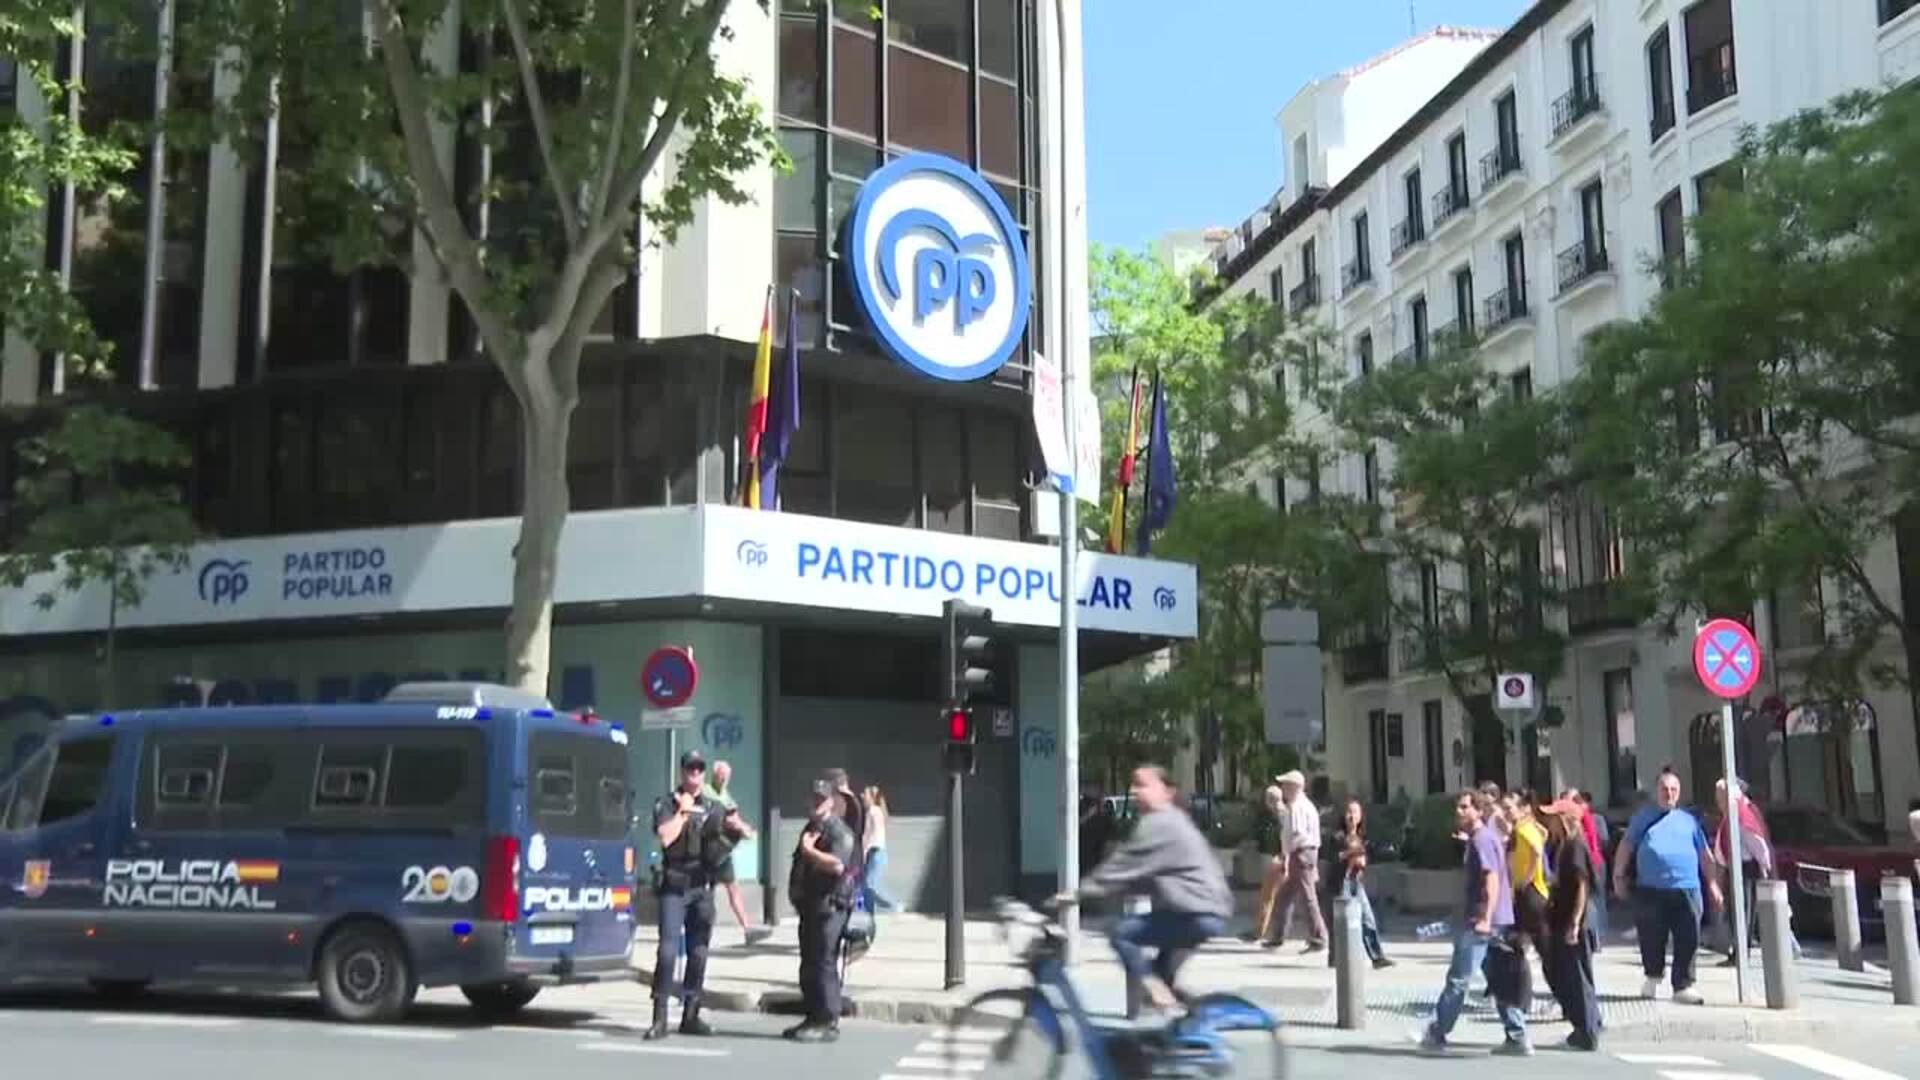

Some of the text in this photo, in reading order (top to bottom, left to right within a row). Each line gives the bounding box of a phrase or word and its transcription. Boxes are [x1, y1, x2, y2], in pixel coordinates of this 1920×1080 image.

[283, 548, 385, 574] PARTIDO
[797, 543, 964, 593] PARTIDO
[283, 573, 393, 600] POPULAR
[105, 859, 241, 884] POLICIA
[402, 865, 479, 902] 200
[103, 884, 277, 909] NACIONAL
[524, 886, 615, 911] POLICIA
